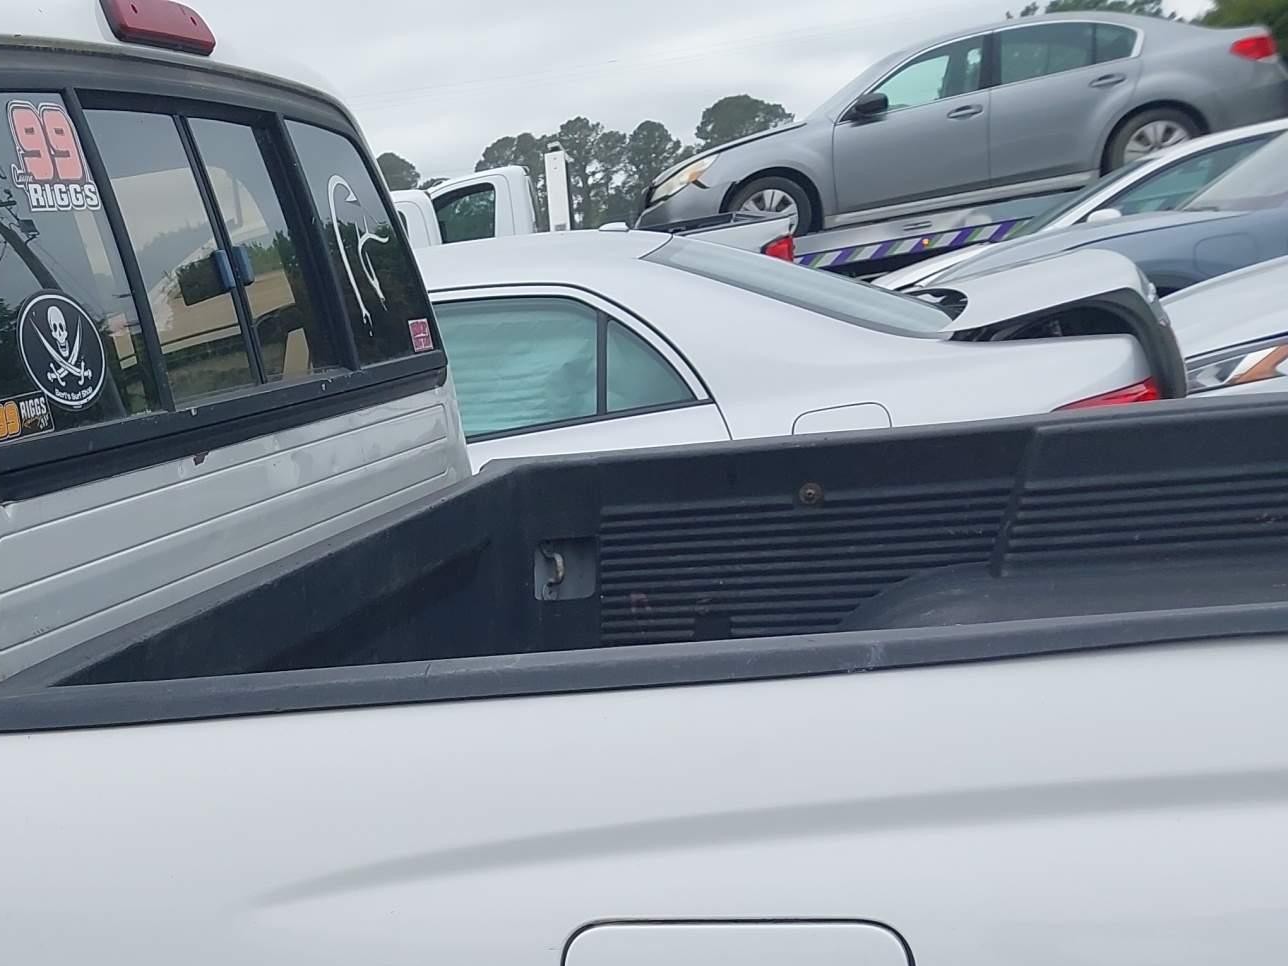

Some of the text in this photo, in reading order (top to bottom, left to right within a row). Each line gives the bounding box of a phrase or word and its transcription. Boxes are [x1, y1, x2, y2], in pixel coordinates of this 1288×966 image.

[9, 102, 86, 182] 99
[28, 182, 100, 208] RIGGS
[19, 397, 47, 420] RIGGS
